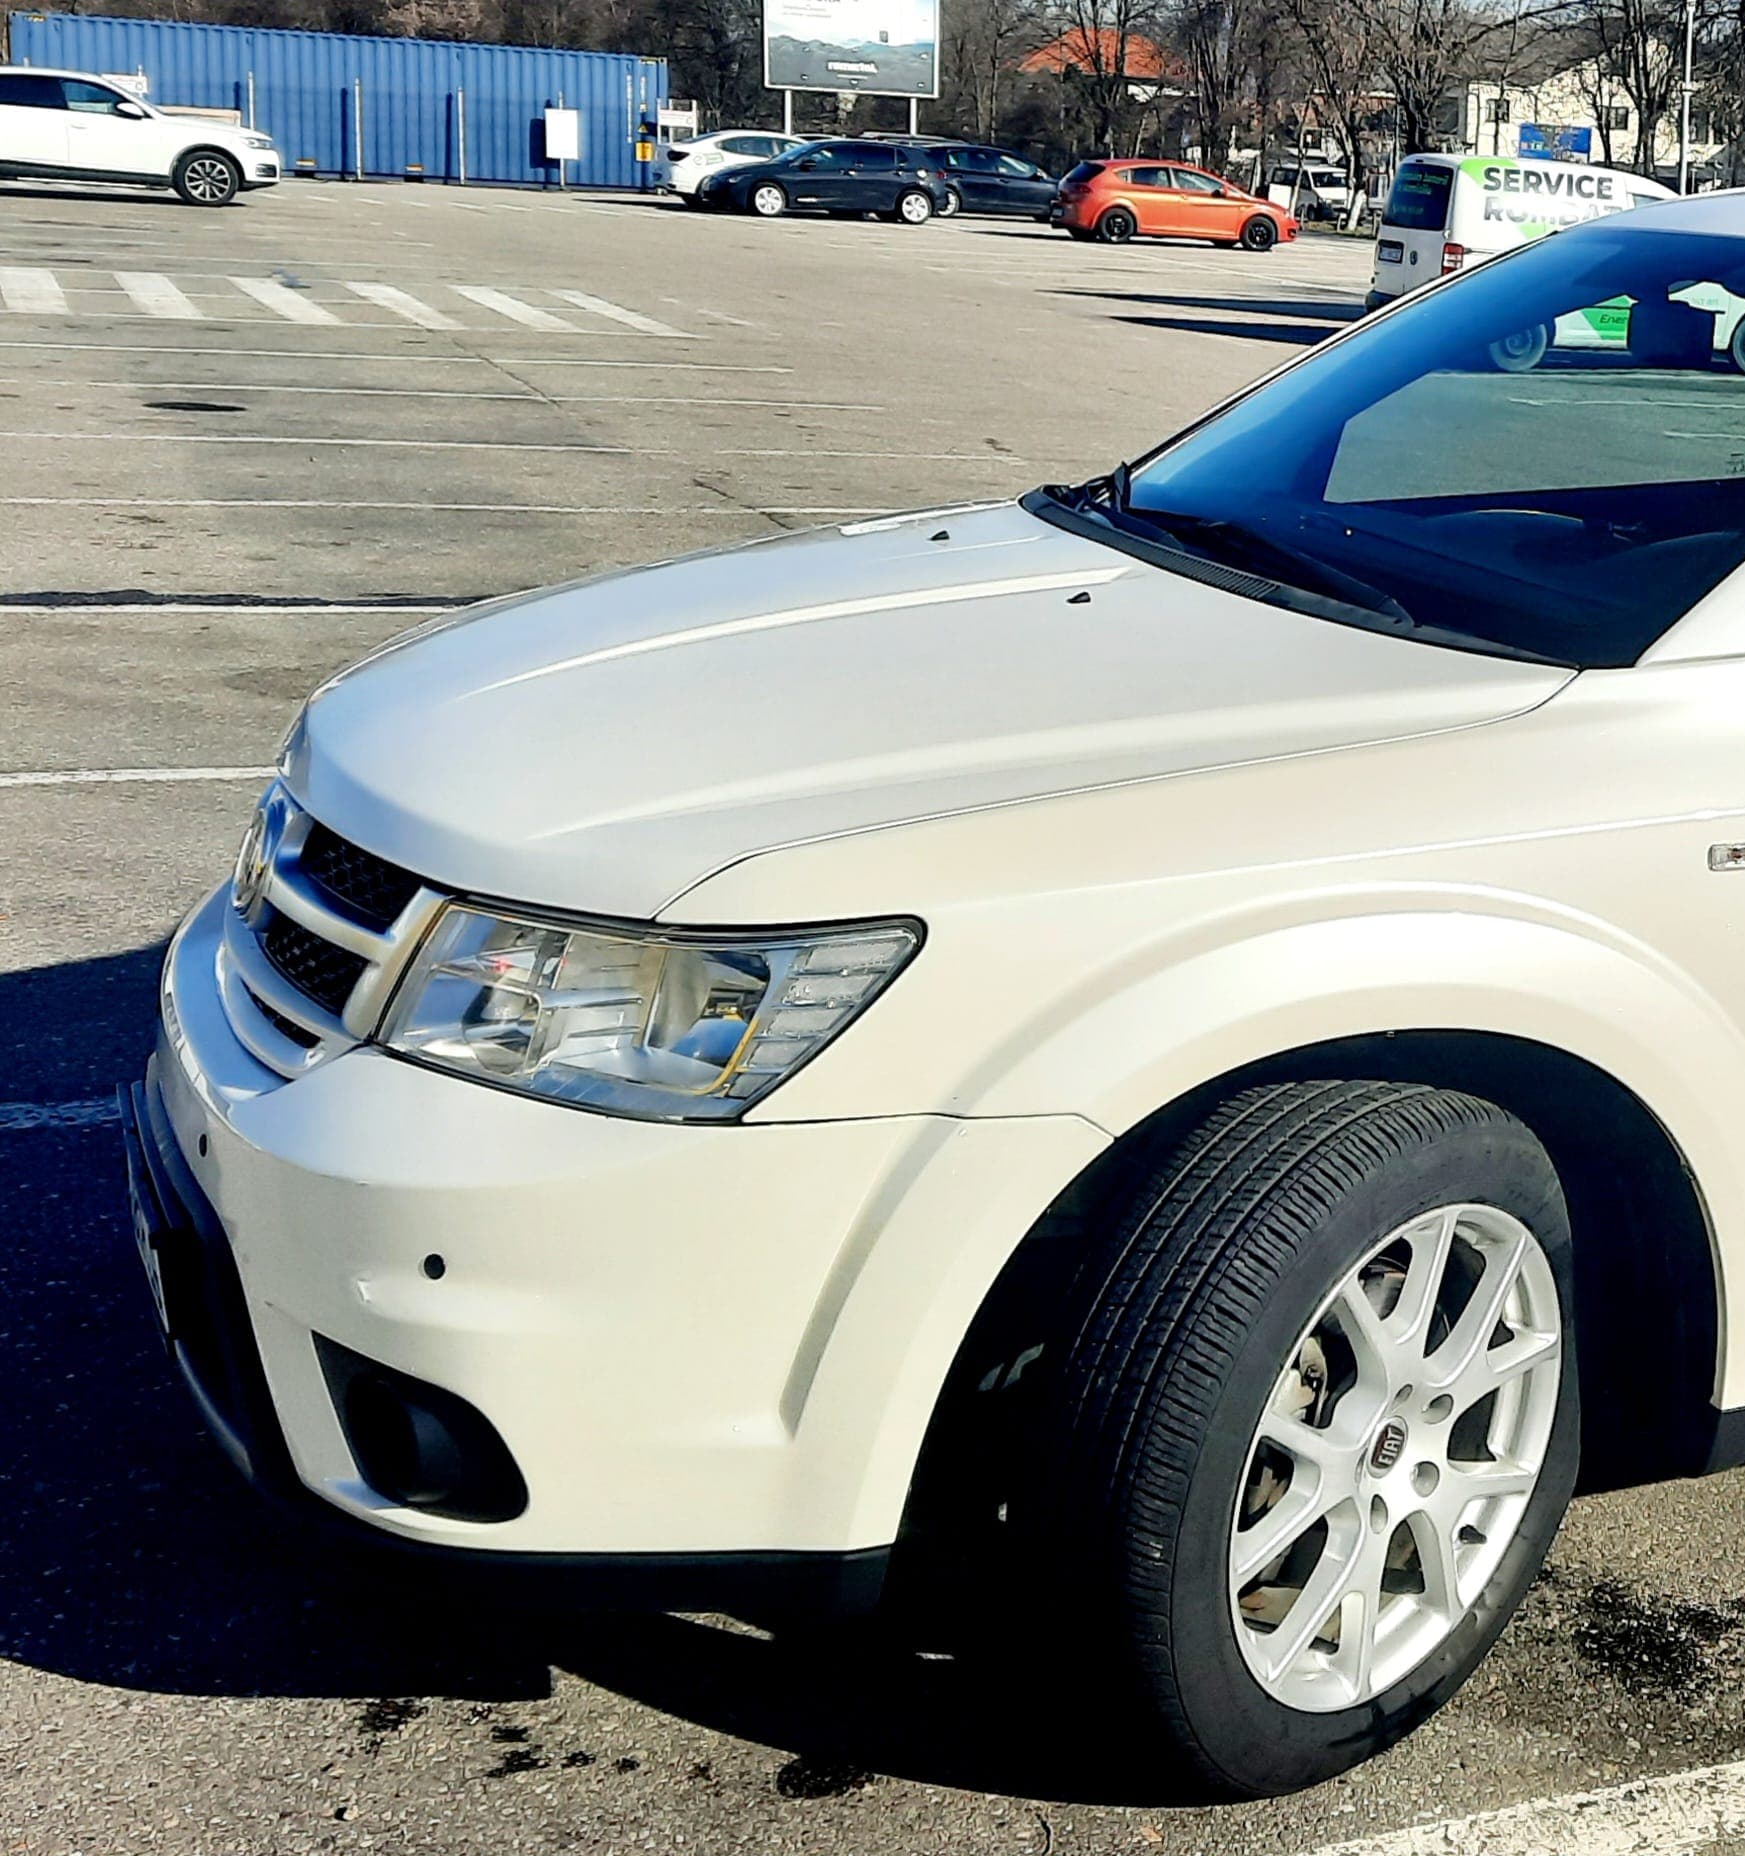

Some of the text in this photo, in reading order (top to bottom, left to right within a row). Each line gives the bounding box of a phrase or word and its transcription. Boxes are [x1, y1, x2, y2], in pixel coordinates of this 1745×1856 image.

[1483, 167, 1613, 200] SERVICE
[1484, 196, 1624, 226] ROBAT
[1378, 1427, 1404, 1465] FIAT
